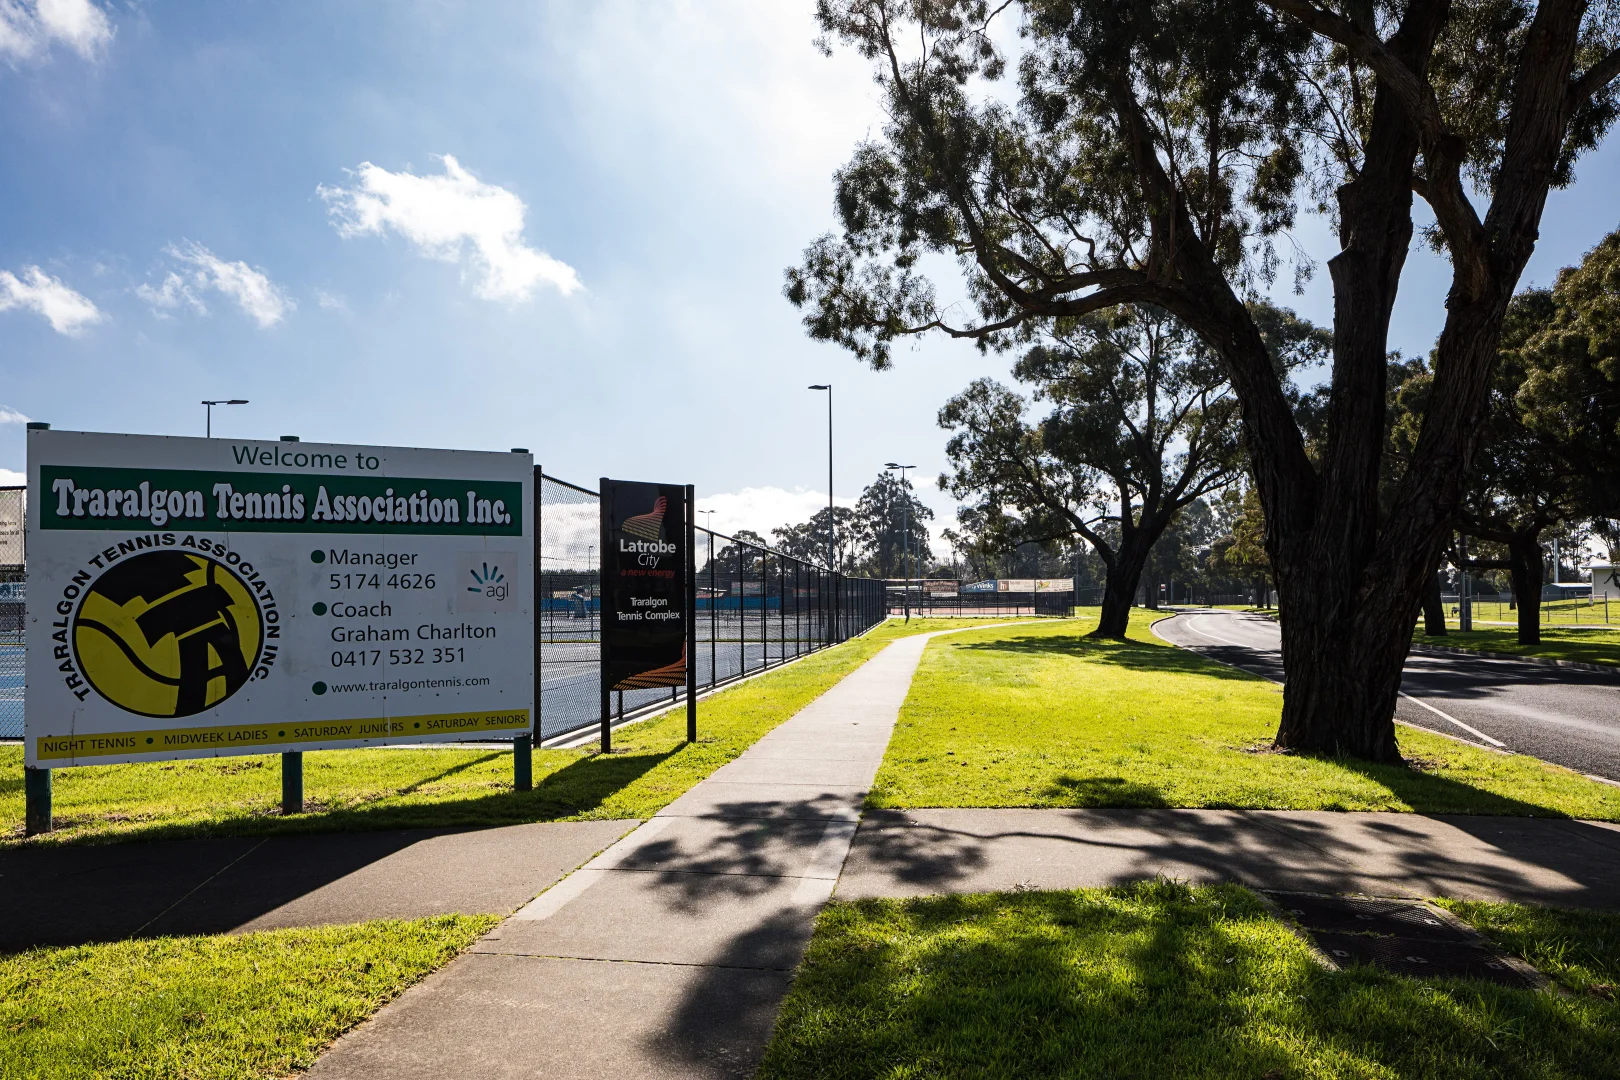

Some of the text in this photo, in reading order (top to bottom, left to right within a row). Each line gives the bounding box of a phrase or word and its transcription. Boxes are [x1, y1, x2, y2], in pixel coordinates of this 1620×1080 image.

[232, 445, 380, 470] Welcome to
[52, 478, 512, 527] Traralgon Tennis Association Inc.
[620, 538, 677, 553] Latrobe
[329, 549, 419, 569] Manager
[637, 553, 660, 569] City
[329, 573, 436, 590] 5174 4626
[621, 569, 676, 578] a new energy
[485, 582, 509, 601] agl
[330, 600, 392, 618] Coach
[630, 596, 668, 608] Traralgon
[52, 532, 280, 702] TRARALGON TENNIS ASSOCIATION INC.
[616, 609, 680, 621] Tennis Complex
[331, 622, 497, 643] Graham Charlton
[331, 647, 465, 667] 0417 532 351
[331, 676, 490, 693] www.traralgontennis.com
[44, 714, 526, 753] NIGHT TENNIS MIDWEEK LADIES SATURDAY JUNIORS SATURDAY SENIORS
